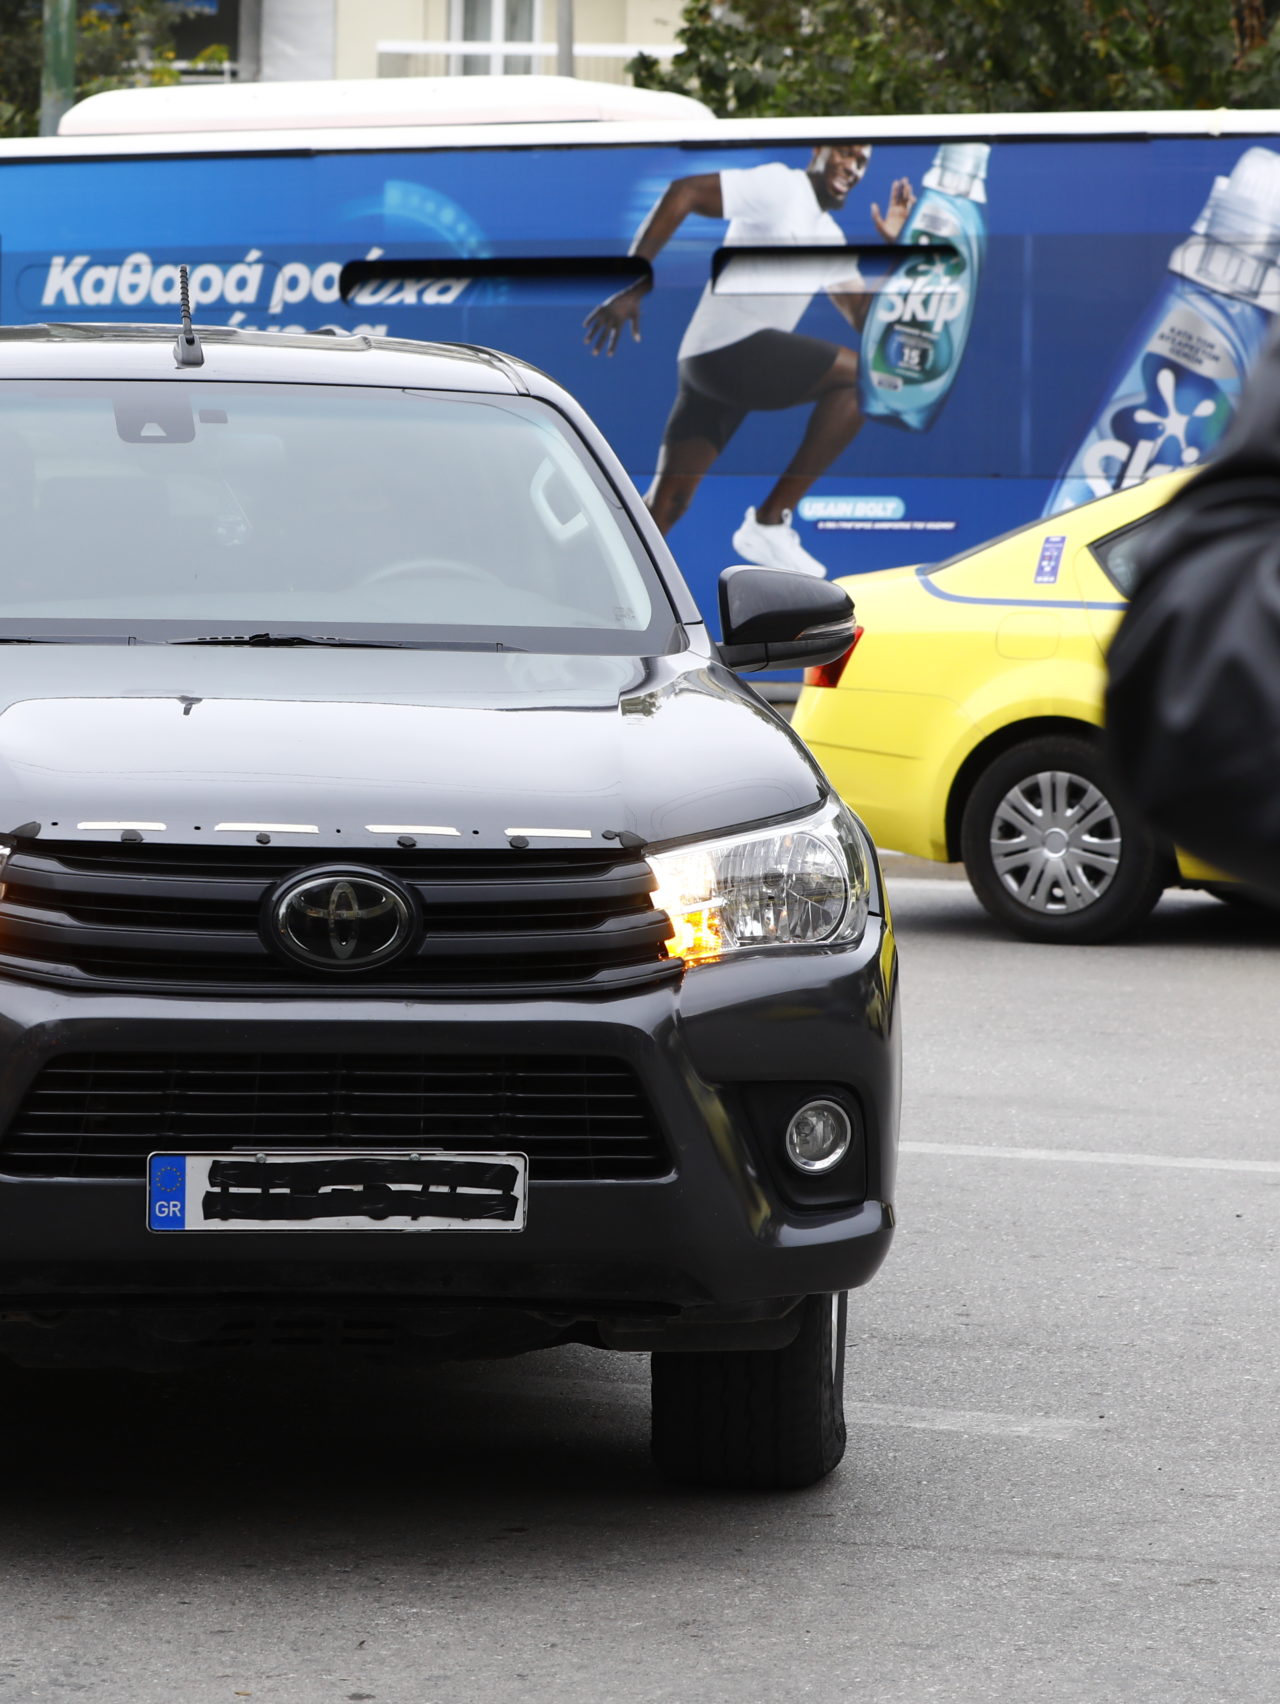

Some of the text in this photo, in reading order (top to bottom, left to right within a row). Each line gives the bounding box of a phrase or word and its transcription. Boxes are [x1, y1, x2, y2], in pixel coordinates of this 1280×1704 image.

[41, 250, 264, 315] Καθαρά
[877, 275, 968, 333] Skip
[854, 502, 898, 517] BOLT
[155, 1200, 182, 1217] GR
